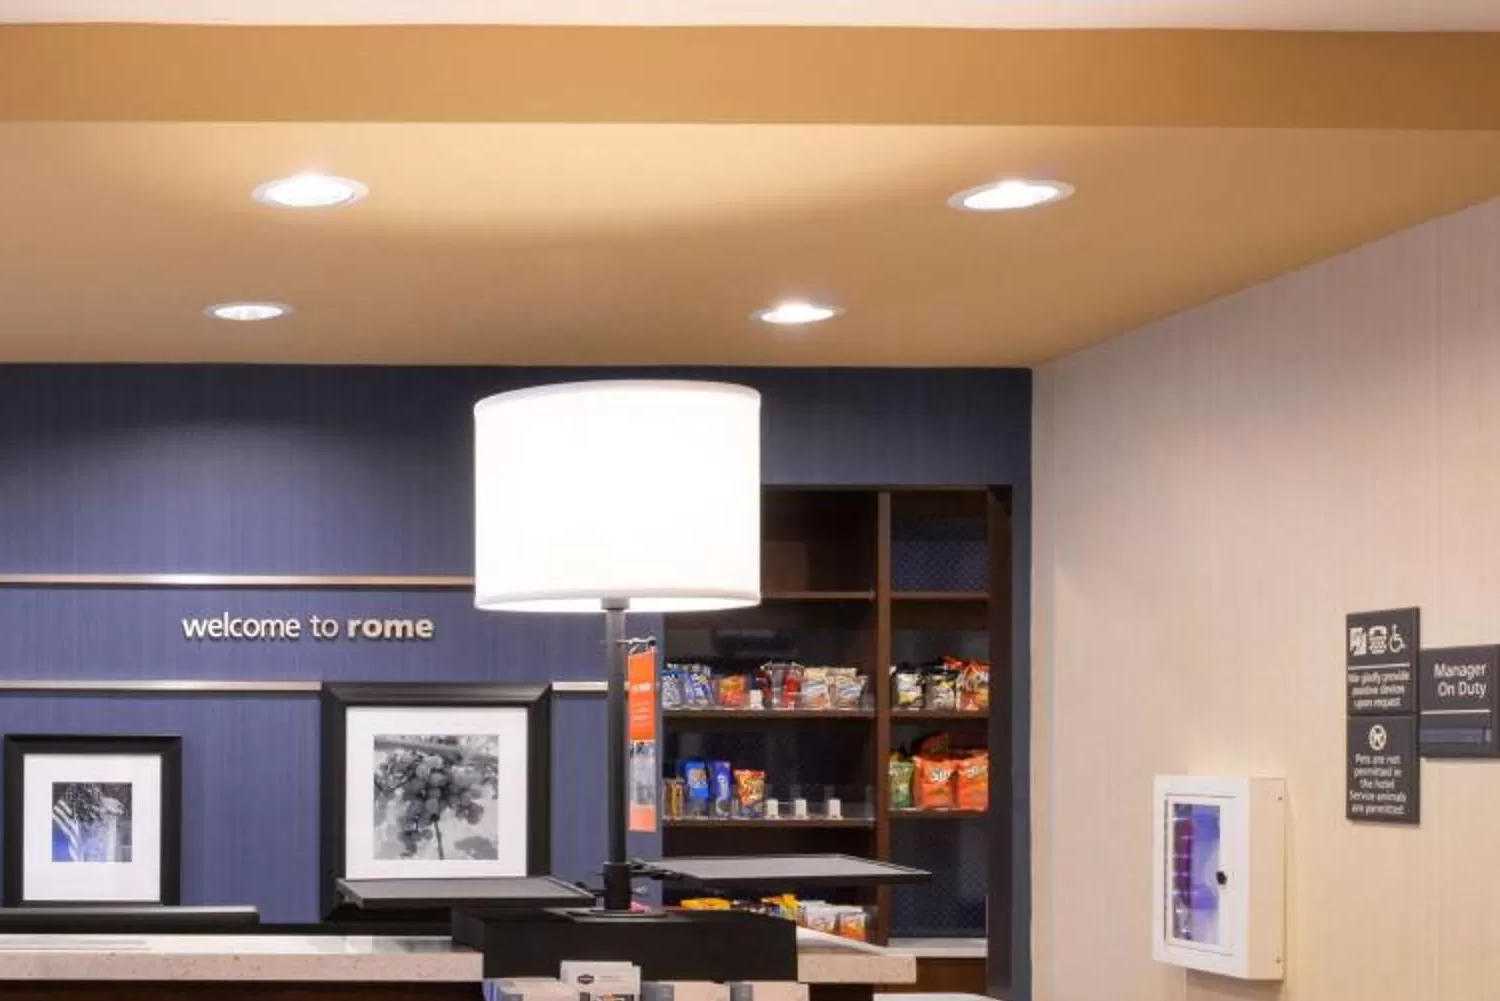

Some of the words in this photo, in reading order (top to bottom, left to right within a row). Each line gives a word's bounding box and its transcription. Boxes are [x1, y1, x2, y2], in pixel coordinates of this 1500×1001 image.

[182, 612, 300, 638] welcome
[309, 615, 338, 638] to
[347, 618, 434, 638] rome
[1434, 663, 1487, 680] Manager
[1438, 681, 1455, 697] On
[1458, 681, 1487, 699] Duty
